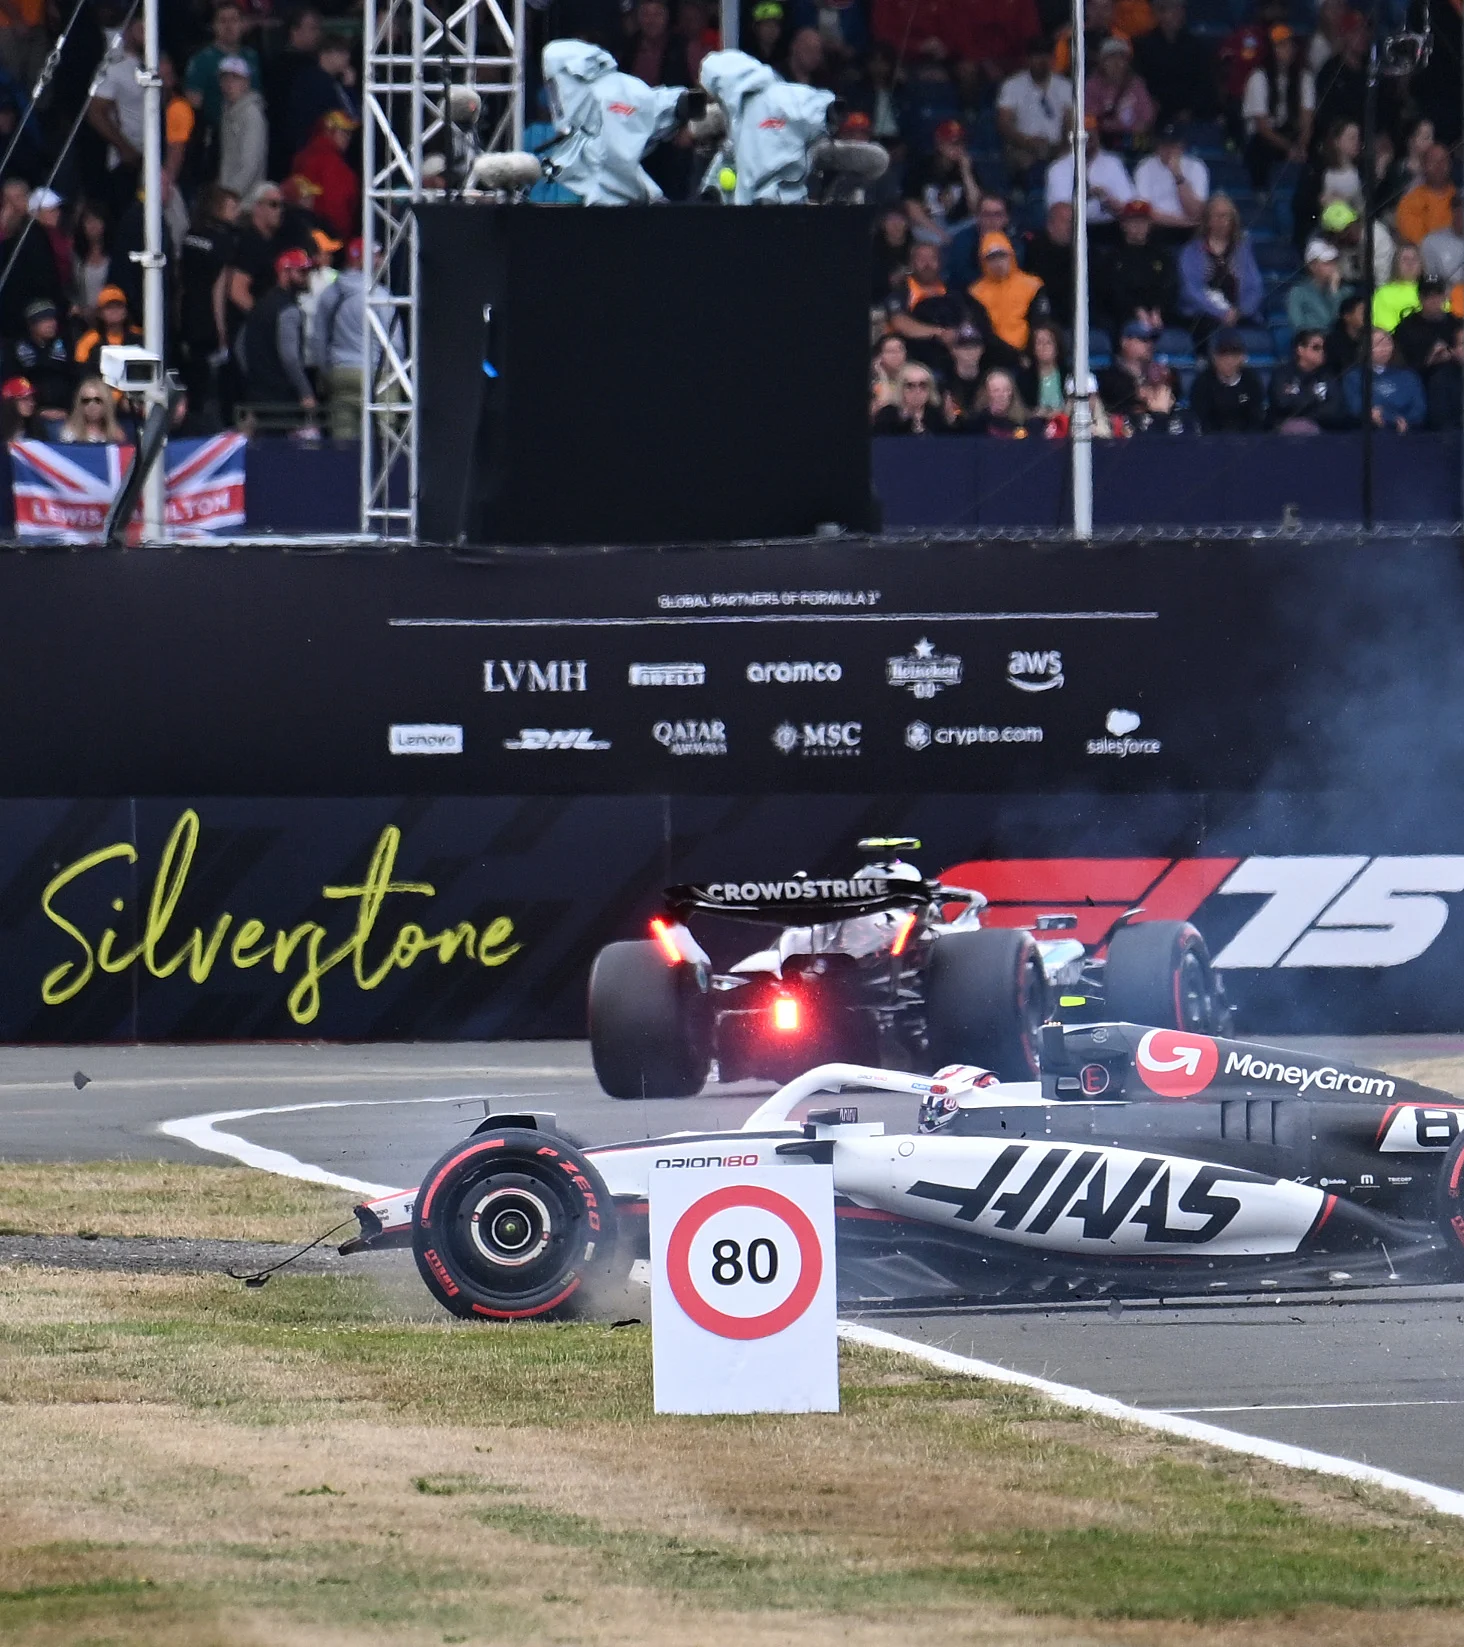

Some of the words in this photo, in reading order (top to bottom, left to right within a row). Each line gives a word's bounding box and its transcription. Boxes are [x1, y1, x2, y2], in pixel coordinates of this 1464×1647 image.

[657, 594, 709, 609] GLOBAL
[711, 592, 779, 608] PARTNERS
[781, 591, 798, 606] OF
[800, 590, 865, 606] FORMULA
[746, 661, 842, 683] aramco
[1008, 650, 1063, 675] aws
[482, 660, 588, 692] LVMH
[398, 732, 456, 747] Lenovo
[519, 728, 600, 750] DHL
[652, 718, 726, 747] QATAR
[803, 720, 862, 748] MSC
[934, 722, 1044, 748] crypto.com
[1086, 736, 1162, 758] salesforce
[707, 879, 889, 902] CROWDSTRIKE
[1085, 1066, 1101, 1091] E
[1223, 1051, 1396, 1098] MoneyGram
[906, 1143, 1243, 1245] HAAS
[710, 1236, 780, 1287] 80
